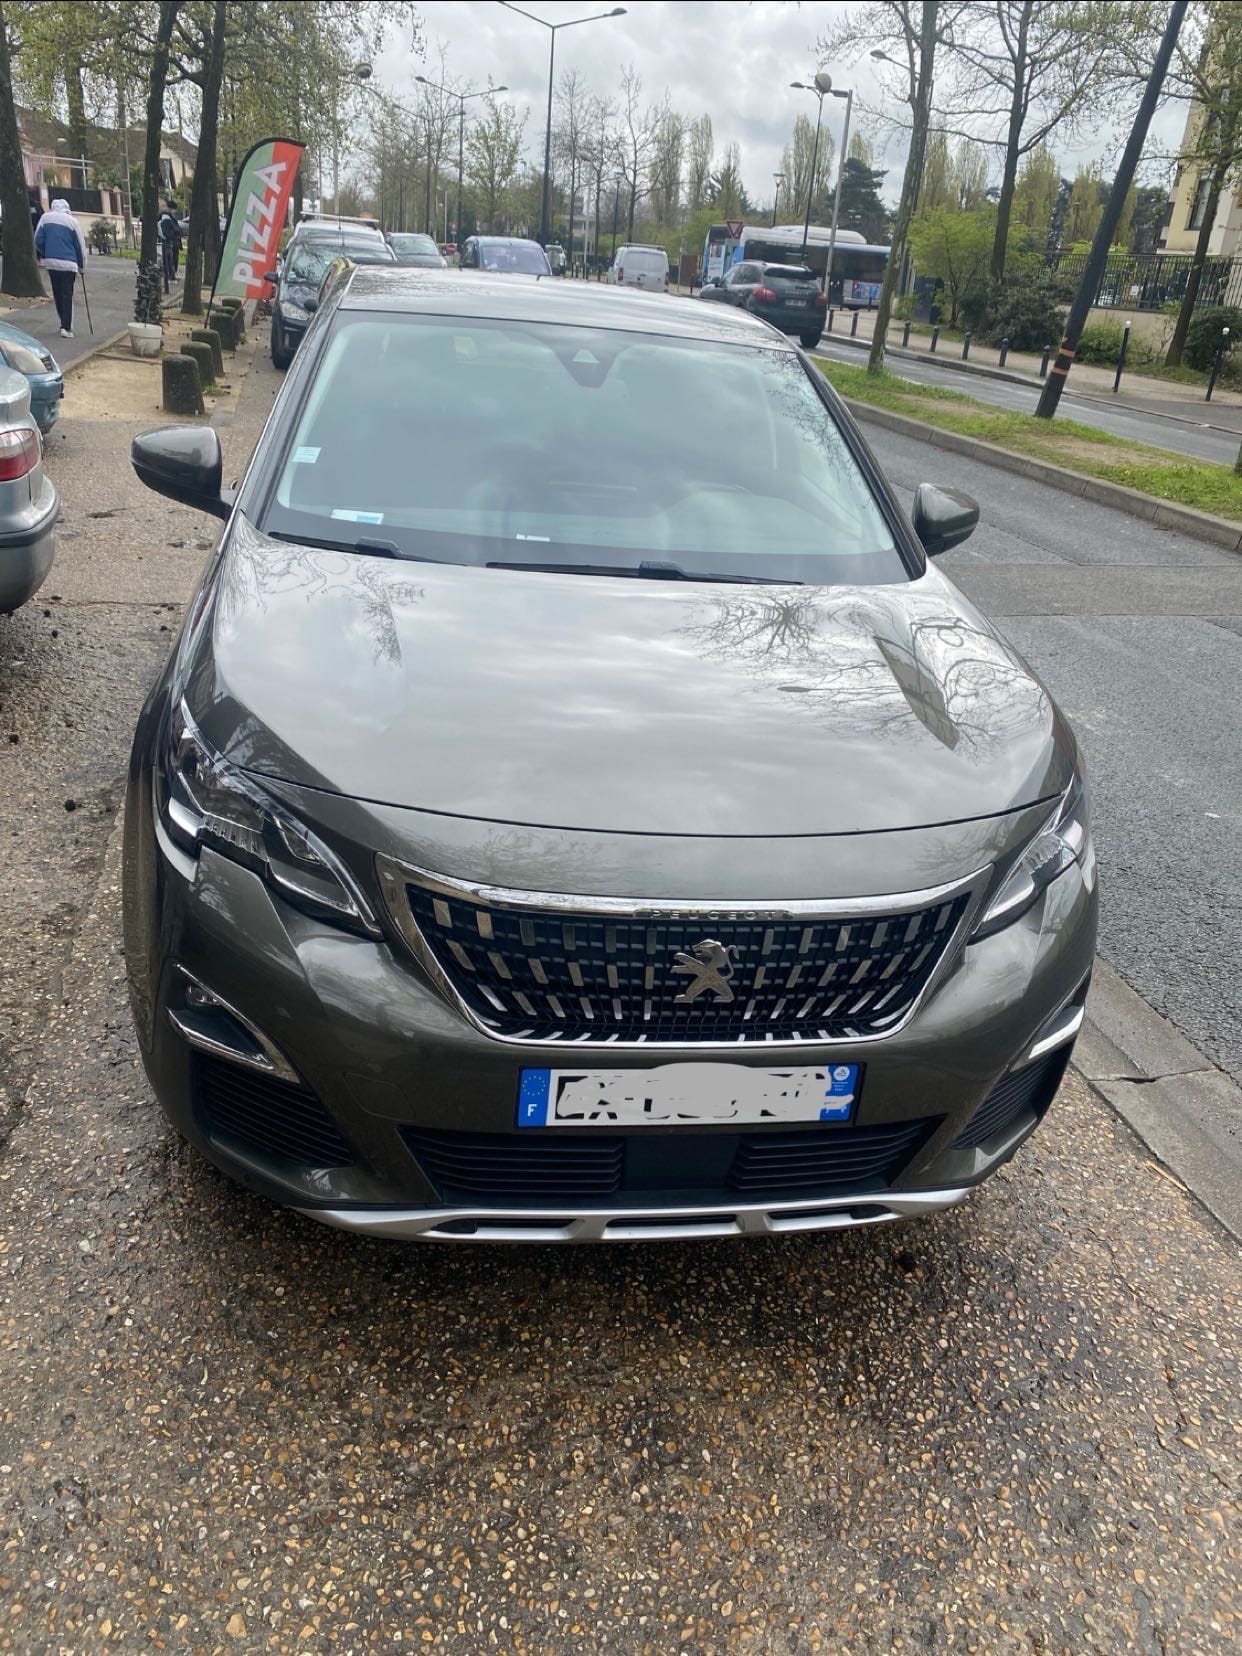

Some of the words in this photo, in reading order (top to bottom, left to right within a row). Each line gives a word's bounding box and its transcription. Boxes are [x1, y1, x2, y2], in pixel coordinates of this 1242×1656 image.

[232, 161, 287, 288] PIZZA
[650, 909, 776, 920] PEUGEOT
[527, 1103, 538, 1117] F
